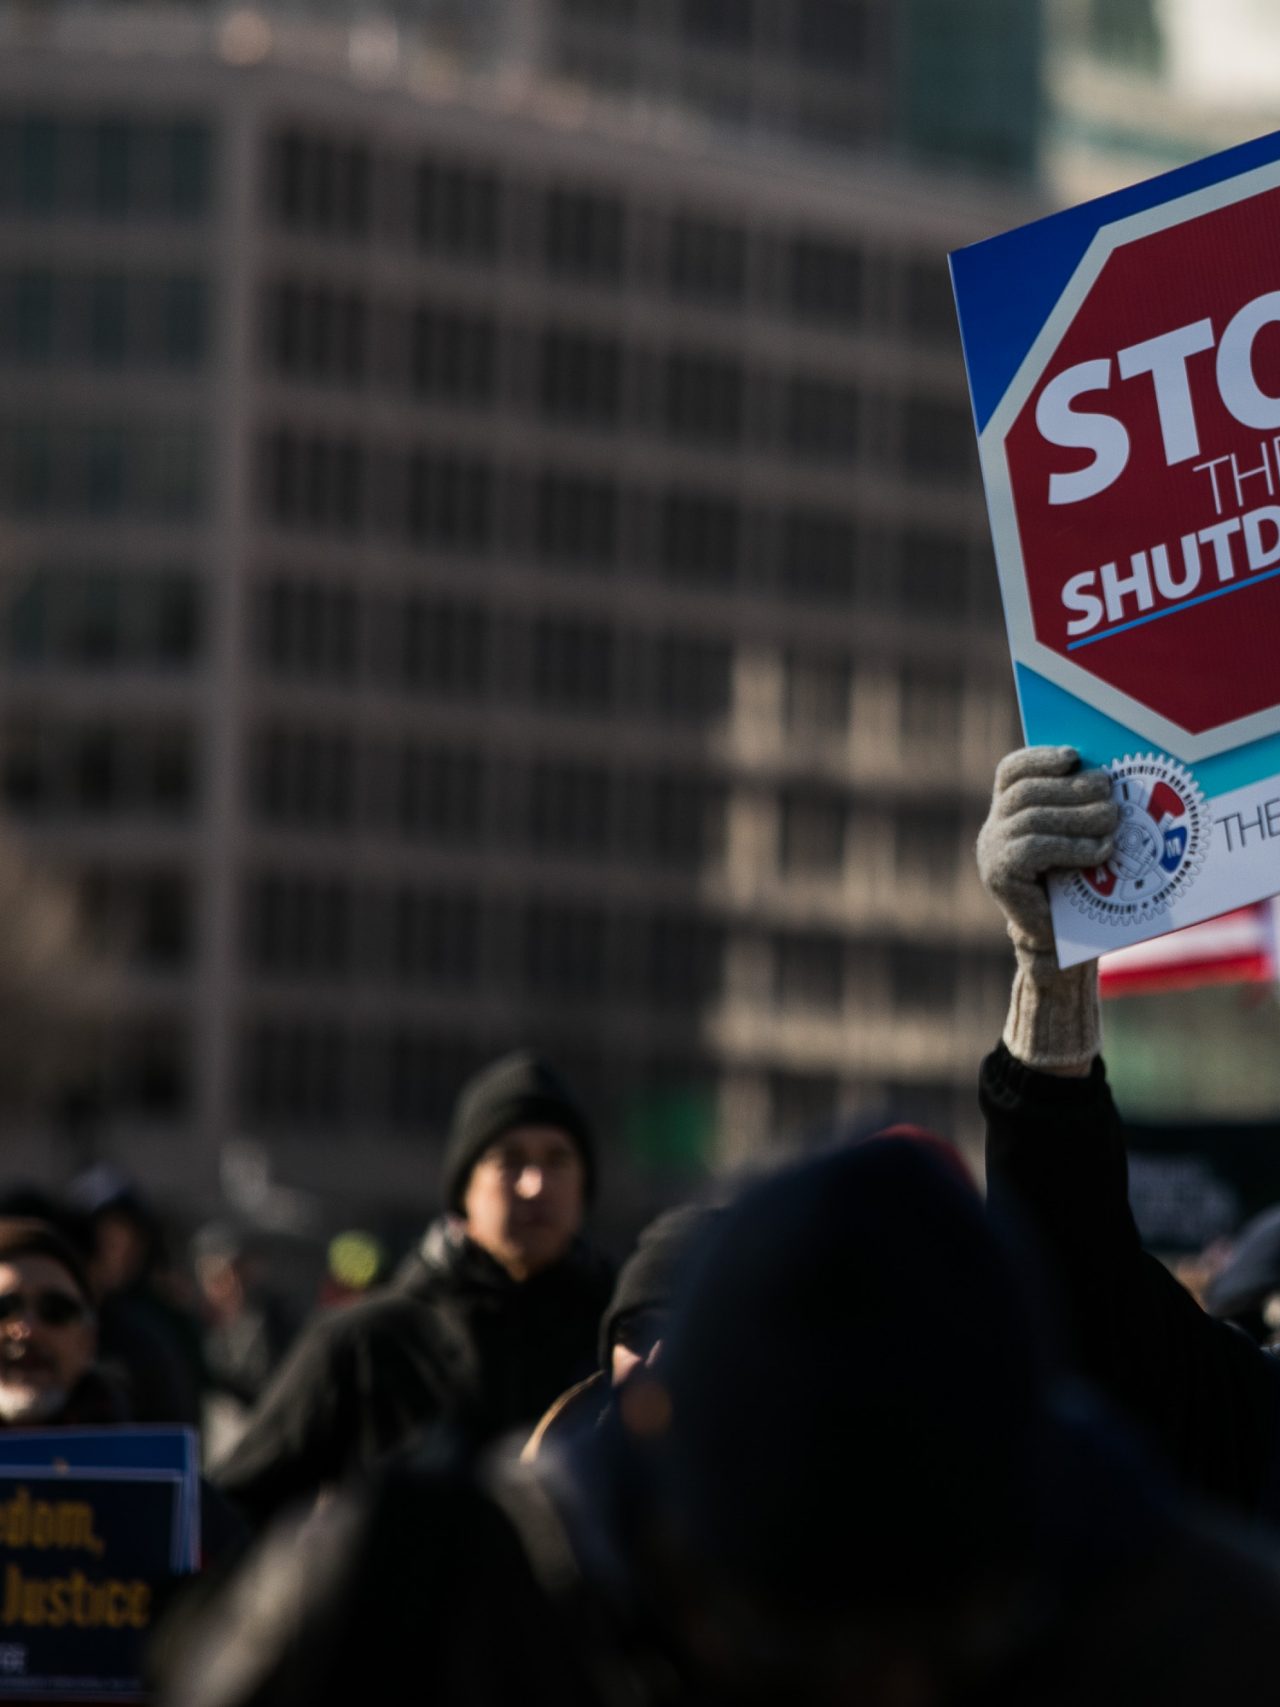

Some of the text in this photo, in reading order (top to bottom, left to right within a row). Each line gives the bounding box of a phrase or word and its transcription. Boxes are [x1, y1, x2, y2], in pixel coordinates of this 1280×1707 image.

[1165, 837, 1182, 859] M
[1152, 859, 1192, 905] WORKERS
[0, 1484, 106, 1560] dom,
[3, 1564, 151, 1628] Justice
